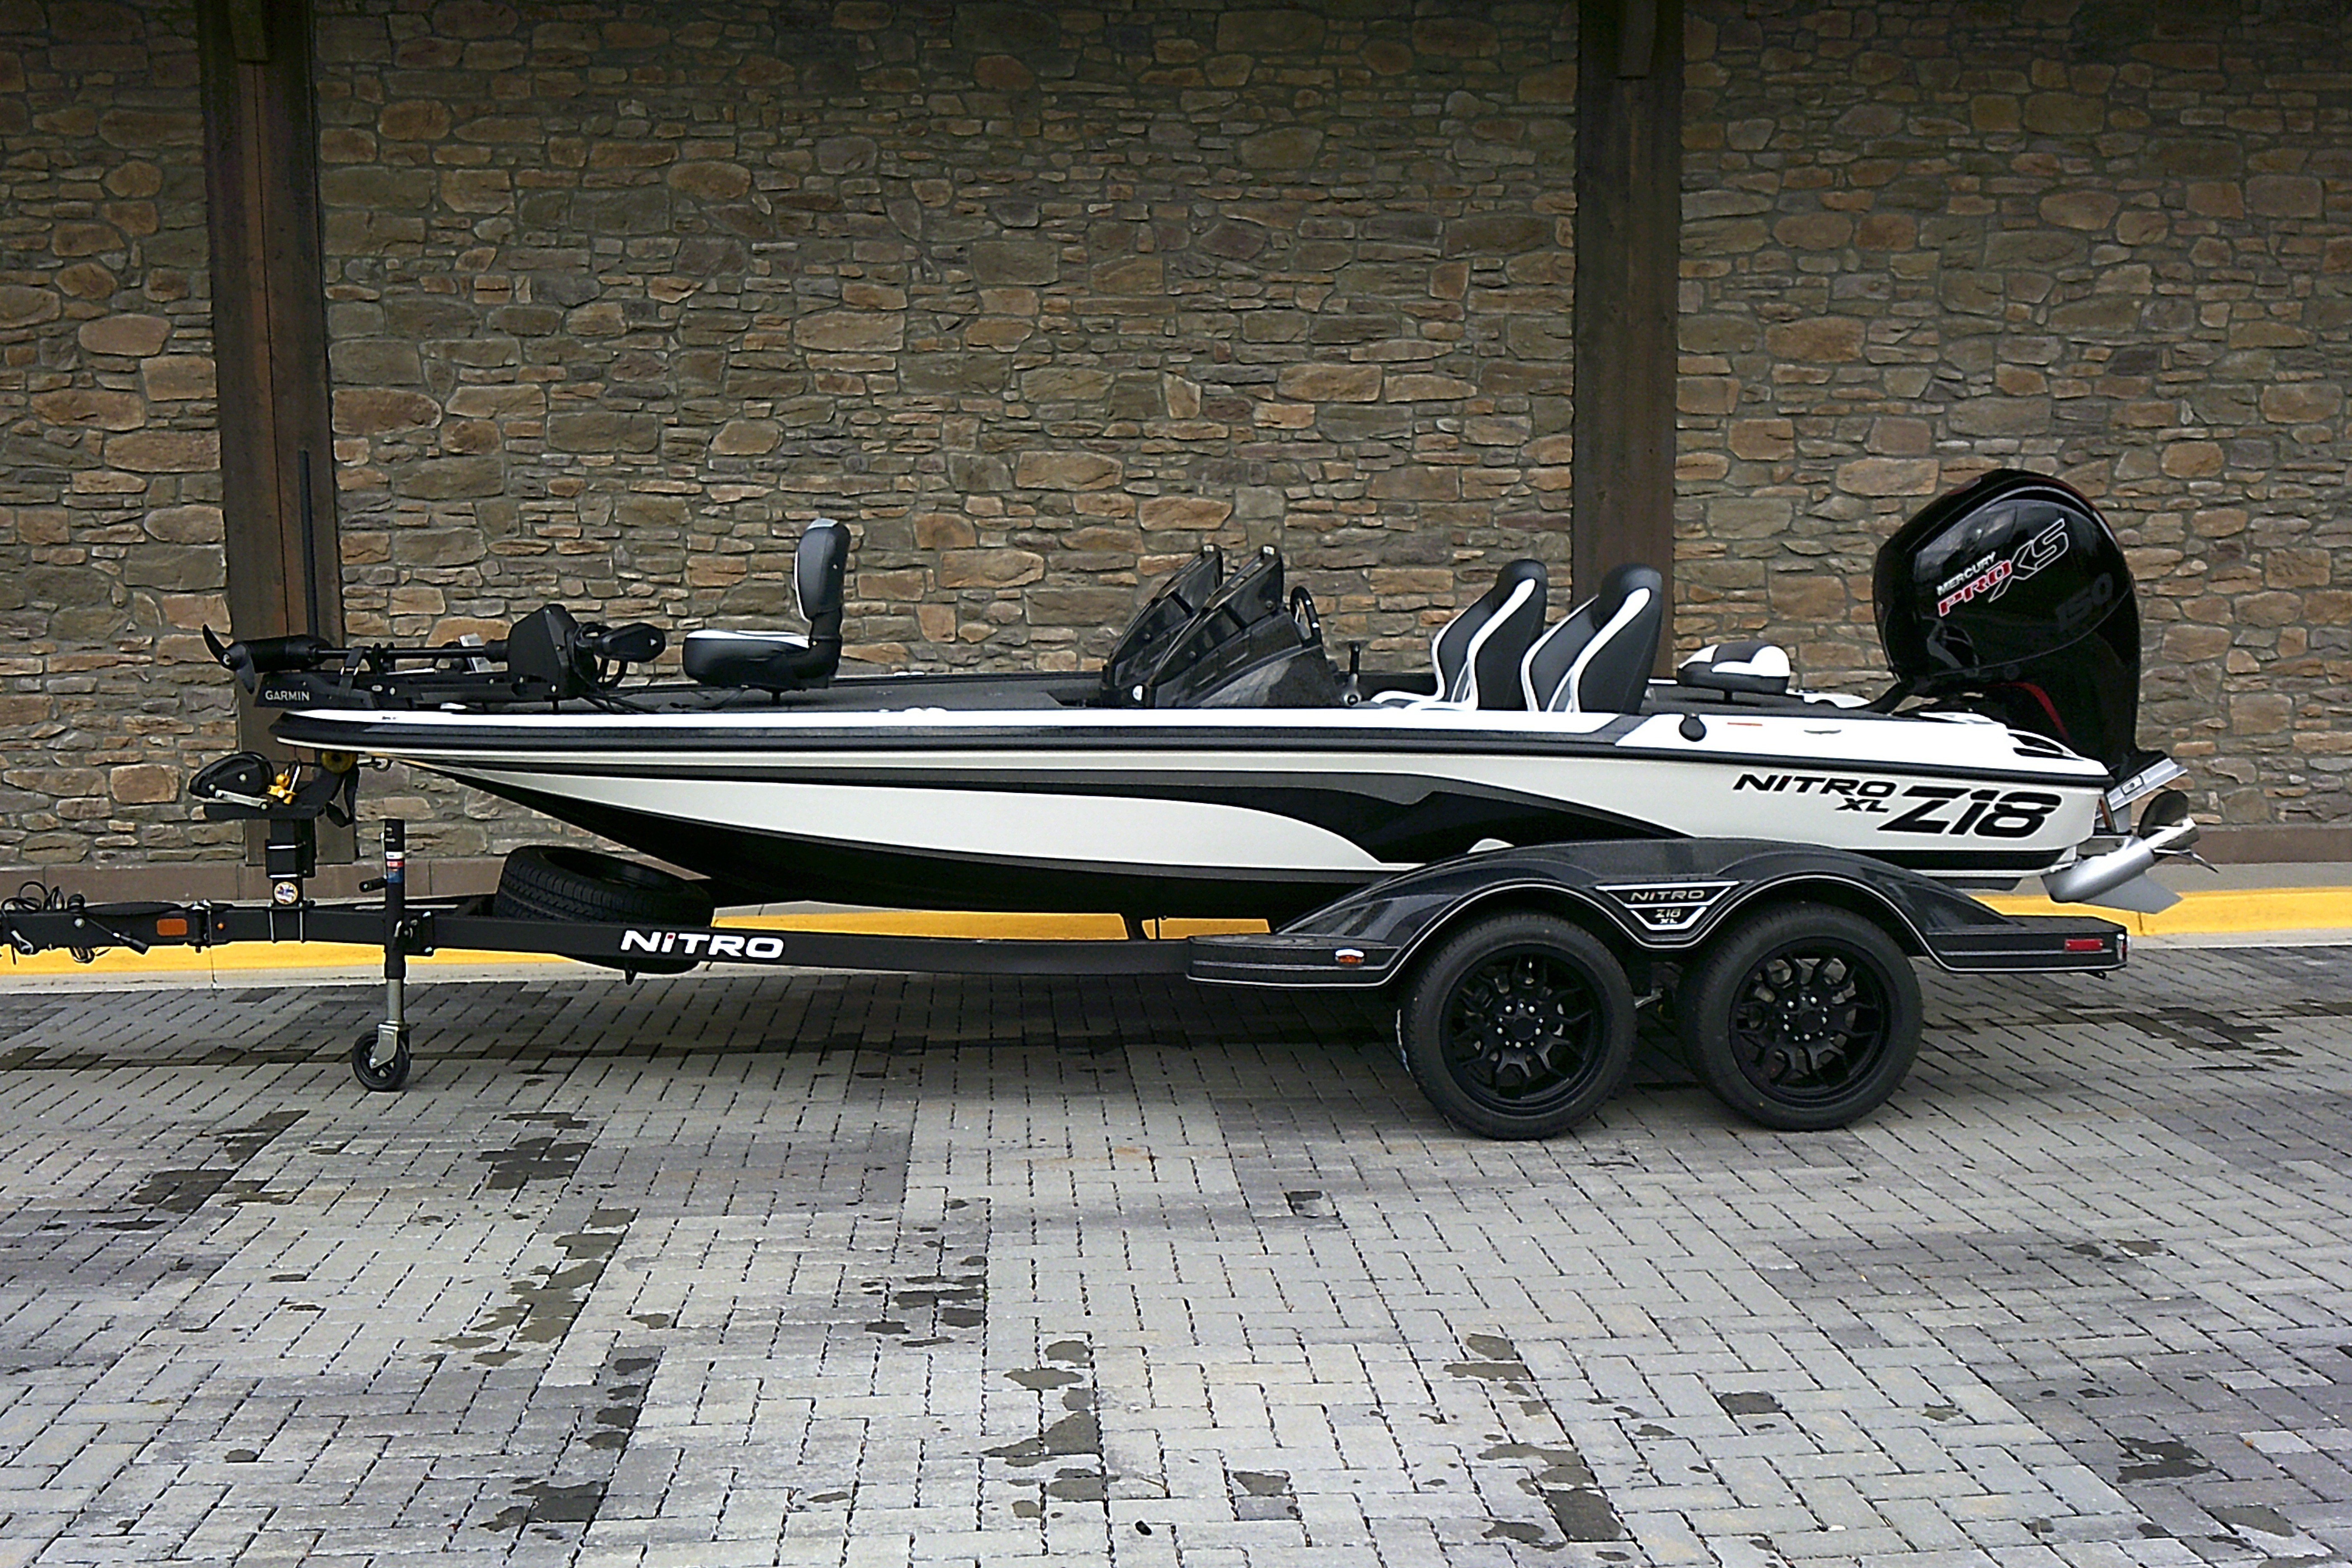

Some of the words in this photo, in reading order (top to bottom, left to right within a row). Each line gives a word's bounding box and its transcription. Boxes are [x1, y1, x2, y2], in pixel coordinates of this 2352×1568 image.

[1936, 552, 1996, 596] MERCURY
[265, 690, 309, 701] GARMIN
[1733, 774, 1897, 797] NITRO
[1877, 786, 2062, 838] Z18
[1835, 798, 1890, 812] XL
[1630, 890, 1705, 901] NITRO
[622, 931, 784, 958] NITRO
